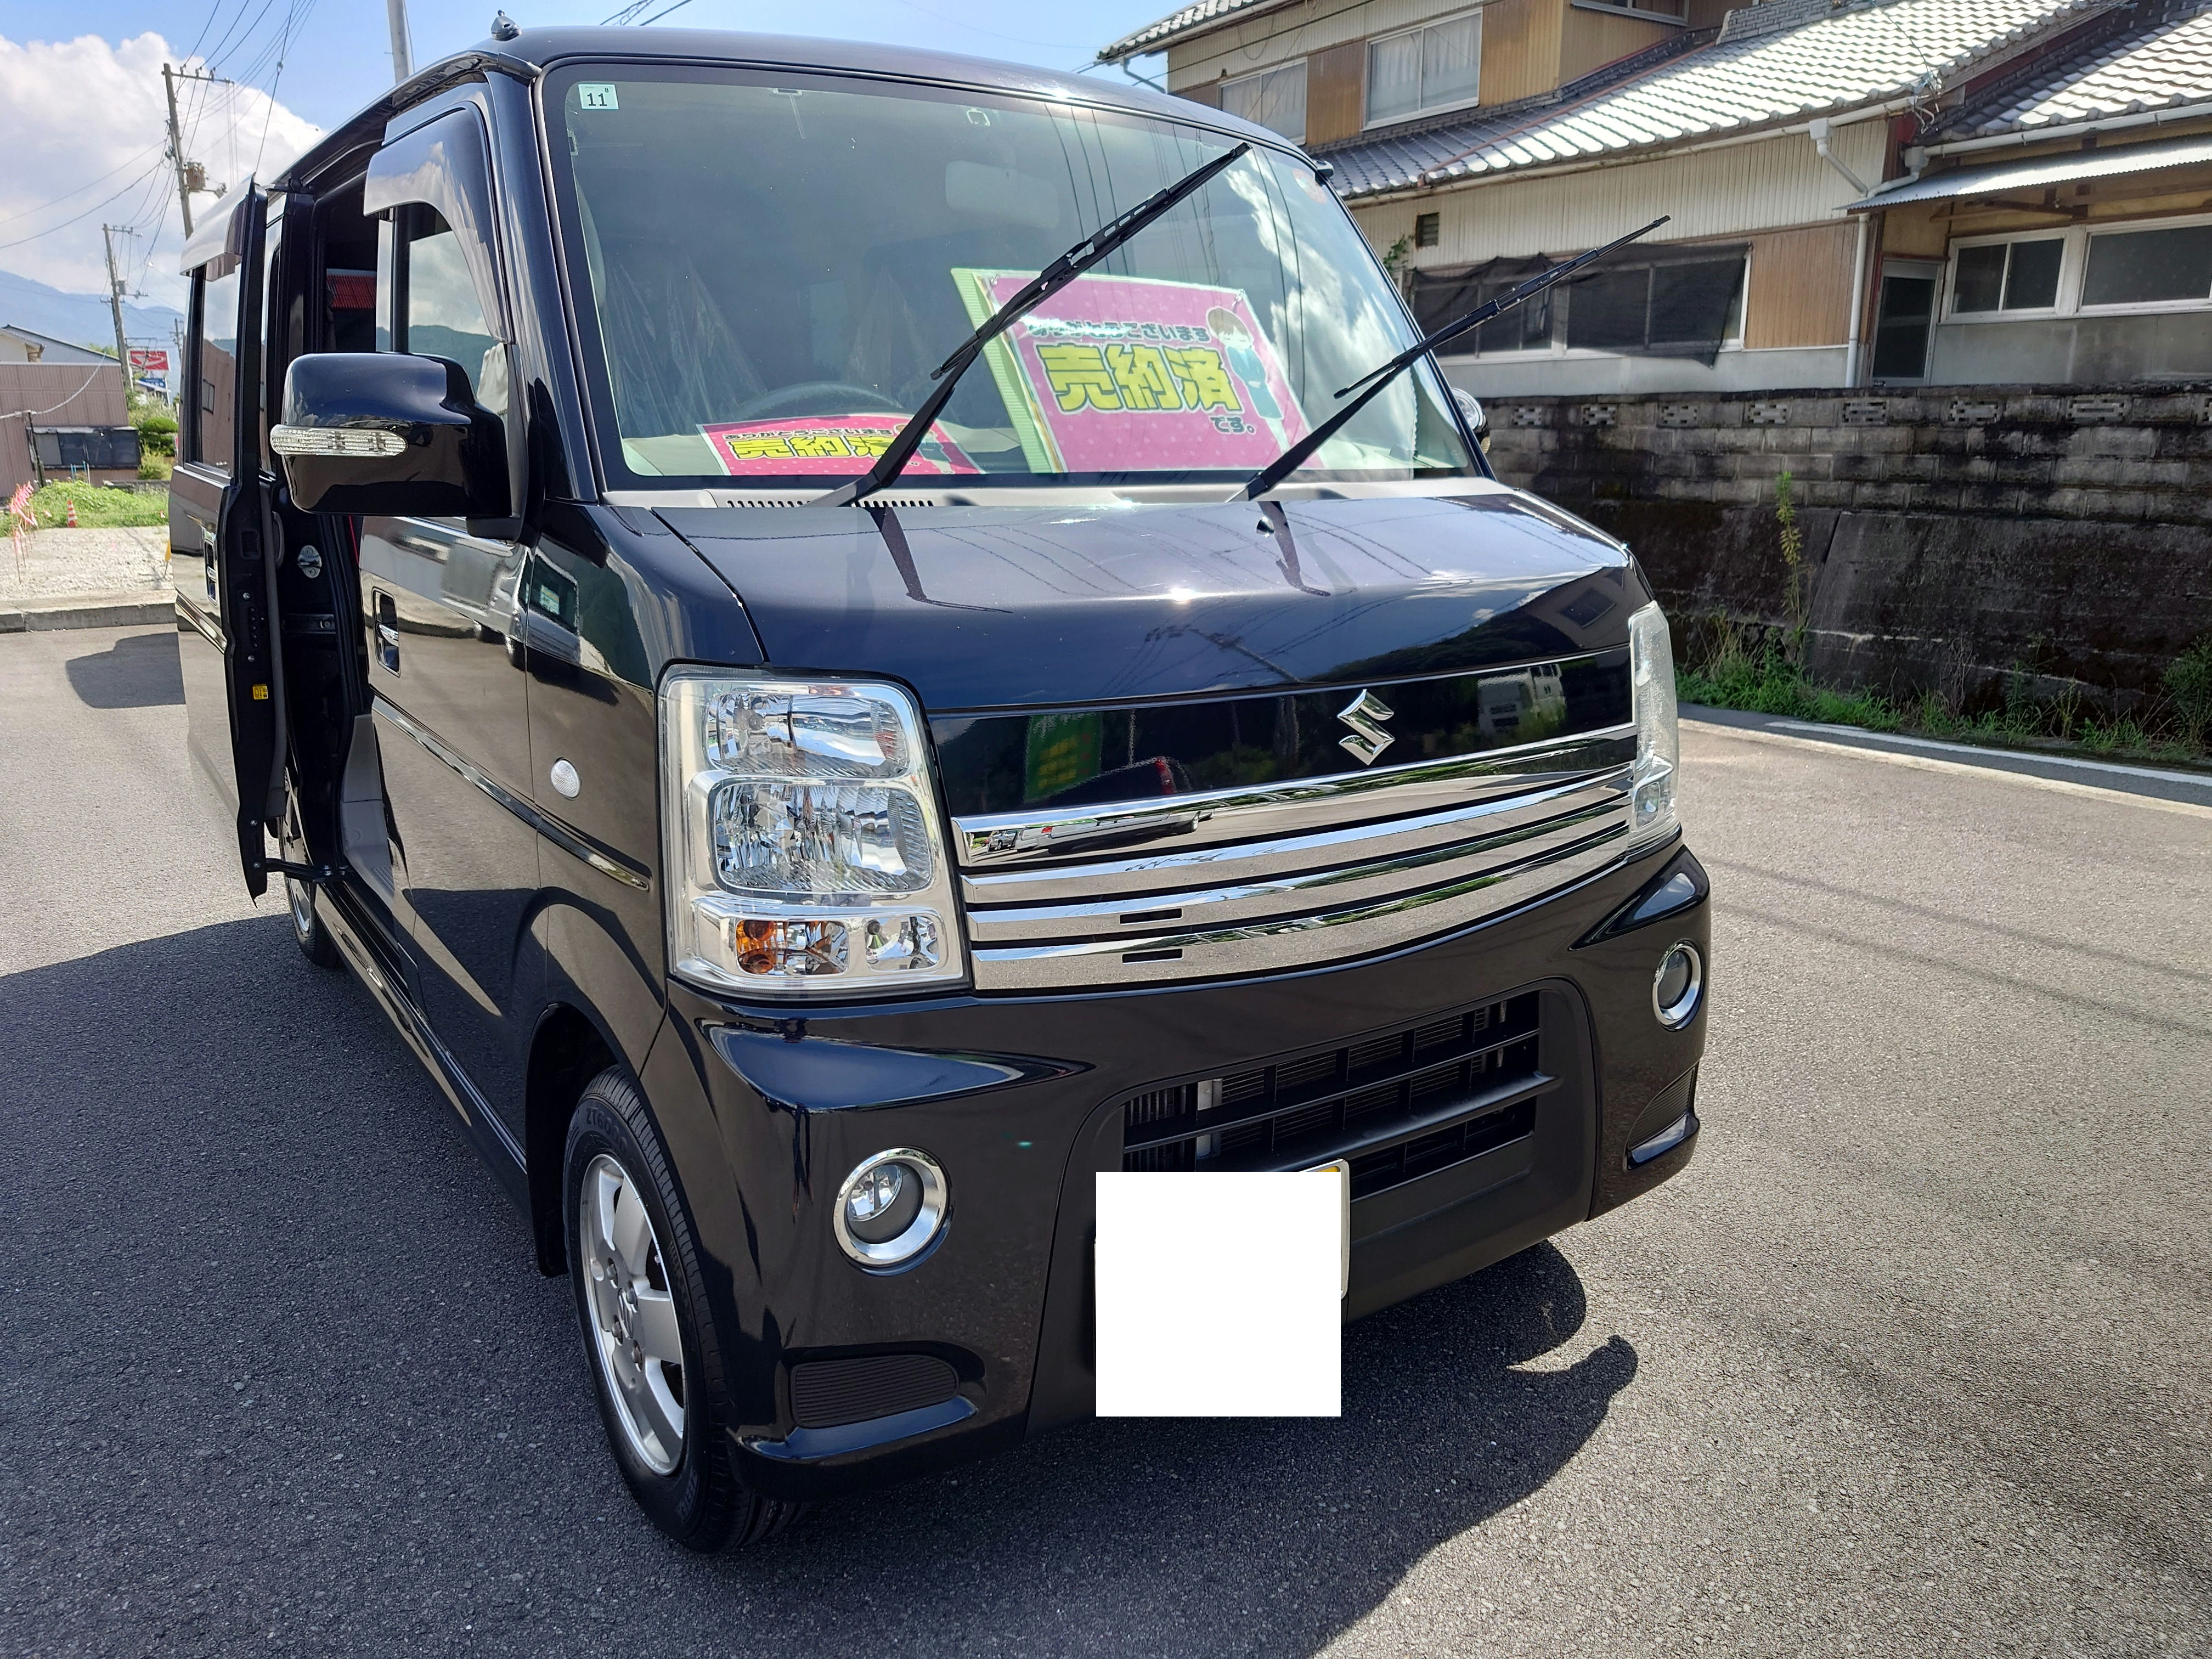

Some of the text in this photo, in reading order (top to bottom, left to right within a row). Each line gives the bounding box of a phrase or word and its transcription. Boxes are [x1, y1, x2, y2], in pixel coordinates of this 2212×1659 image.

[586, 93, 608, 106] 11
[1036, 342, 1244, 411] 売約済
[1209, 415, 1255, 433] です。
[723, 428, 894, 440] ありがとうございます
